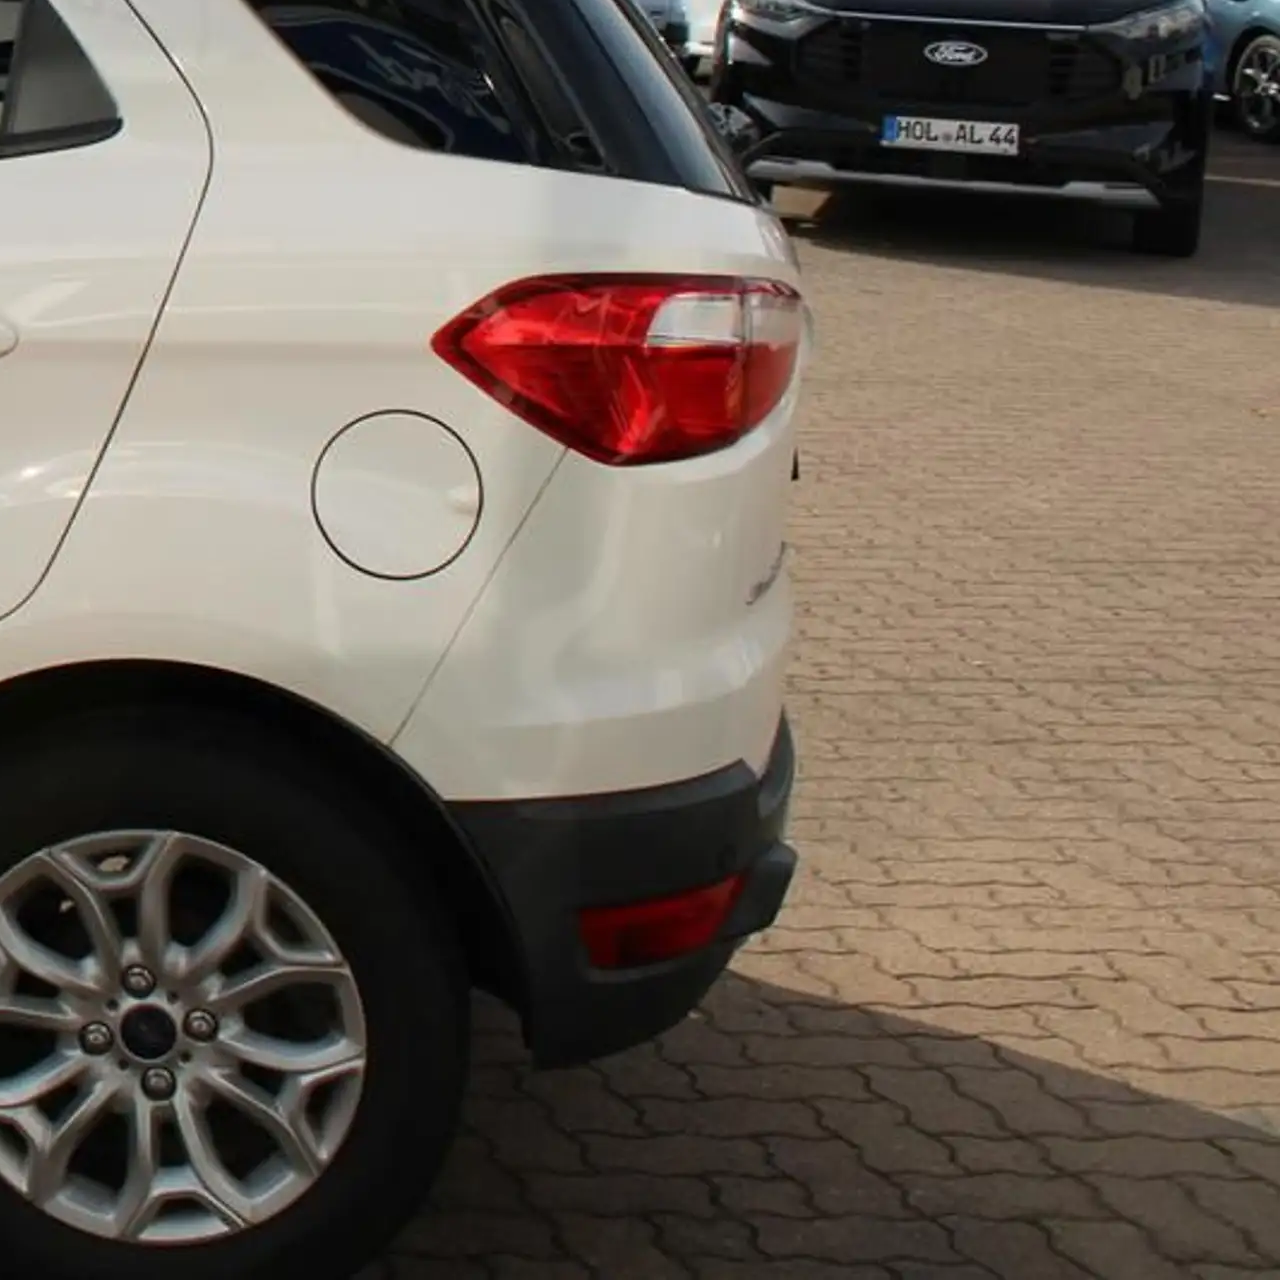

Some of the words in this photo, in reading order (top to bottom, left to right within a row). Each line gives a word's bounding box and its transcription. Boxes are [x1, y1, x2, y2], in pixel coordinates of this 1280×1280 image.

[897, 121, 938, 142] HOL
[955, 124, 983, 145] AL
[988, 125, 1016, 147] 44
